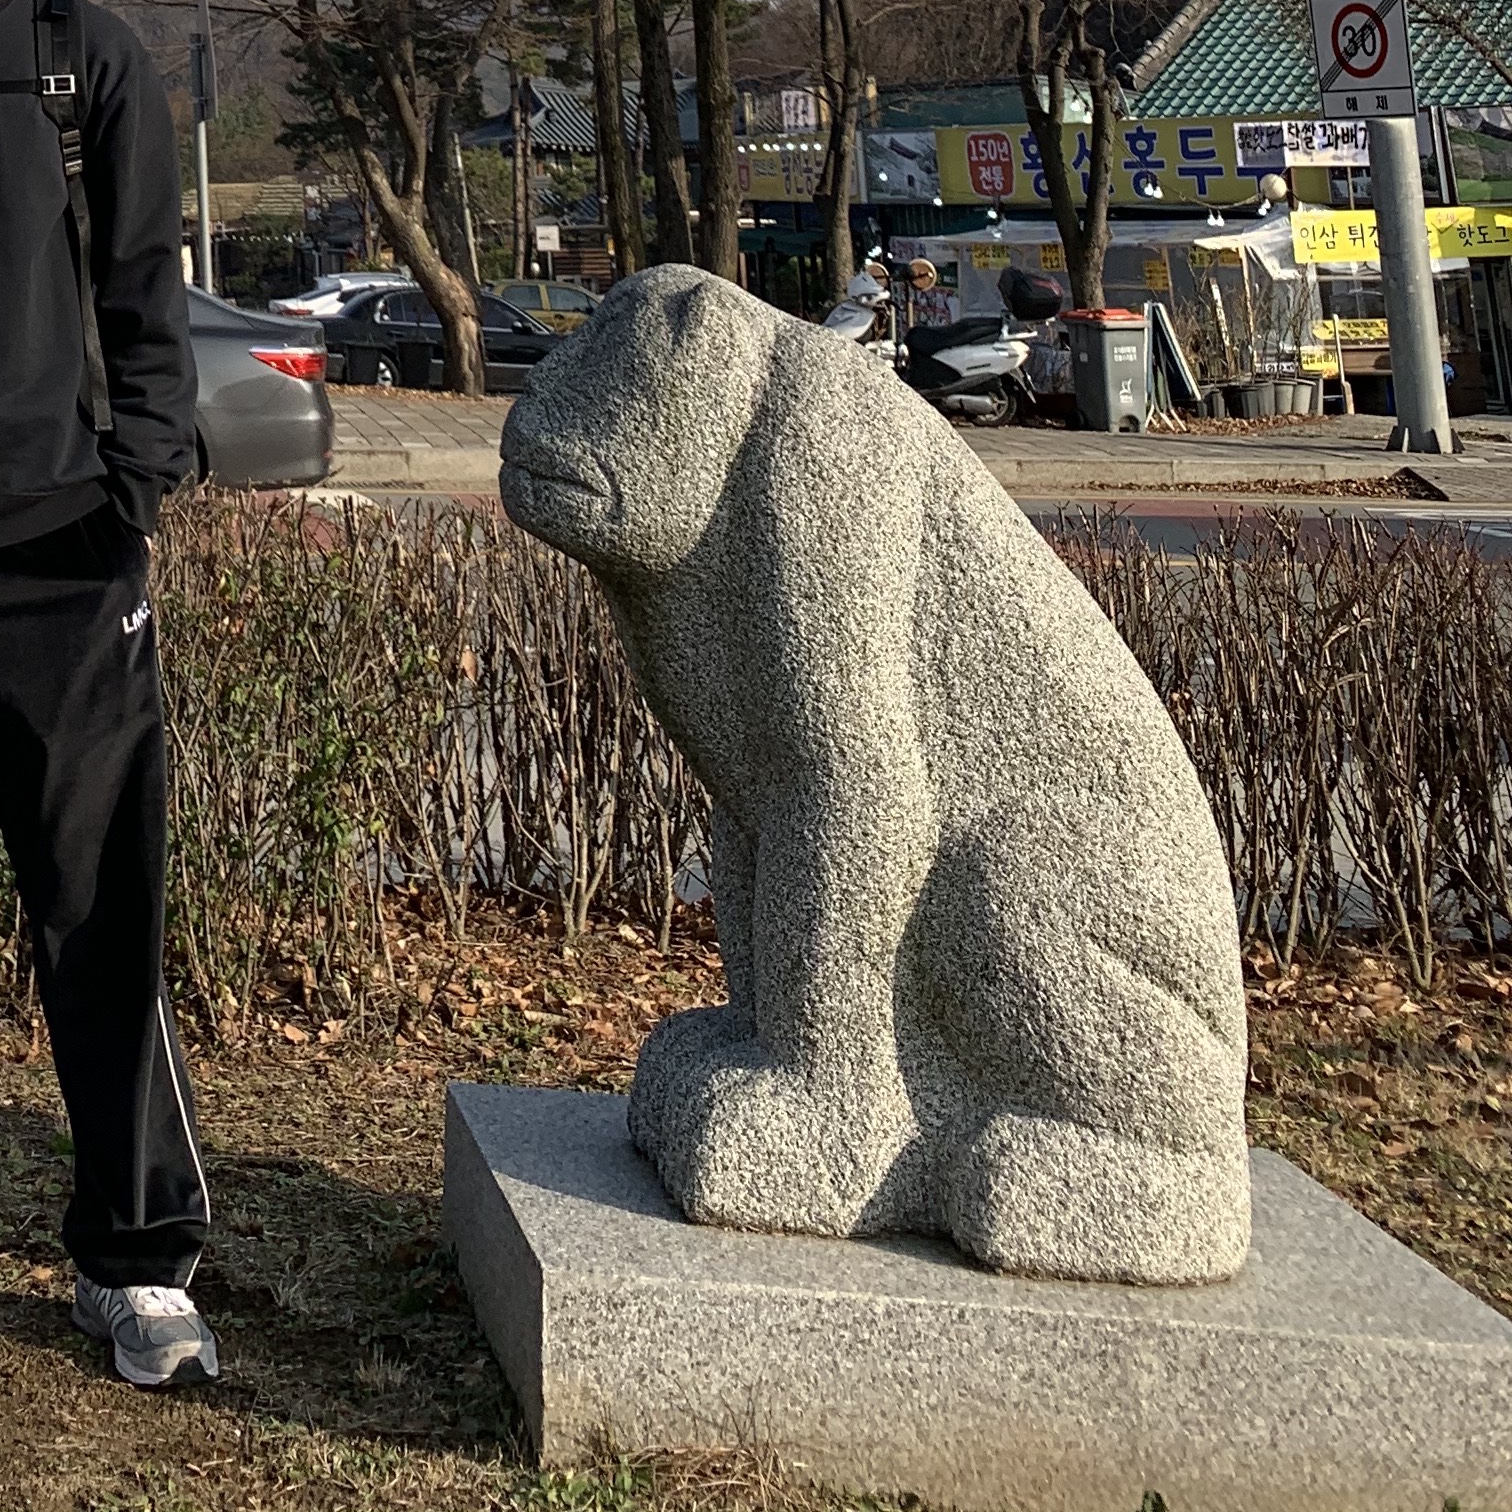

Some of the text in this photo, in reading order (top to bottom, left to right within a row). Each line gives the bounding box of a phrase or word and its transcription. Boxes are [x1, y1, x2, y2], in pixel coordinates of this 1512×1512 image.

[1342, 24, 1377, 58] 30
[968, 139, 1011, 162] 150년
[977, 165, 1005, 191] 전통
[1299, 224, 1339, 250] 인삼
[1456, 223, 1511, 248] 핫도그
